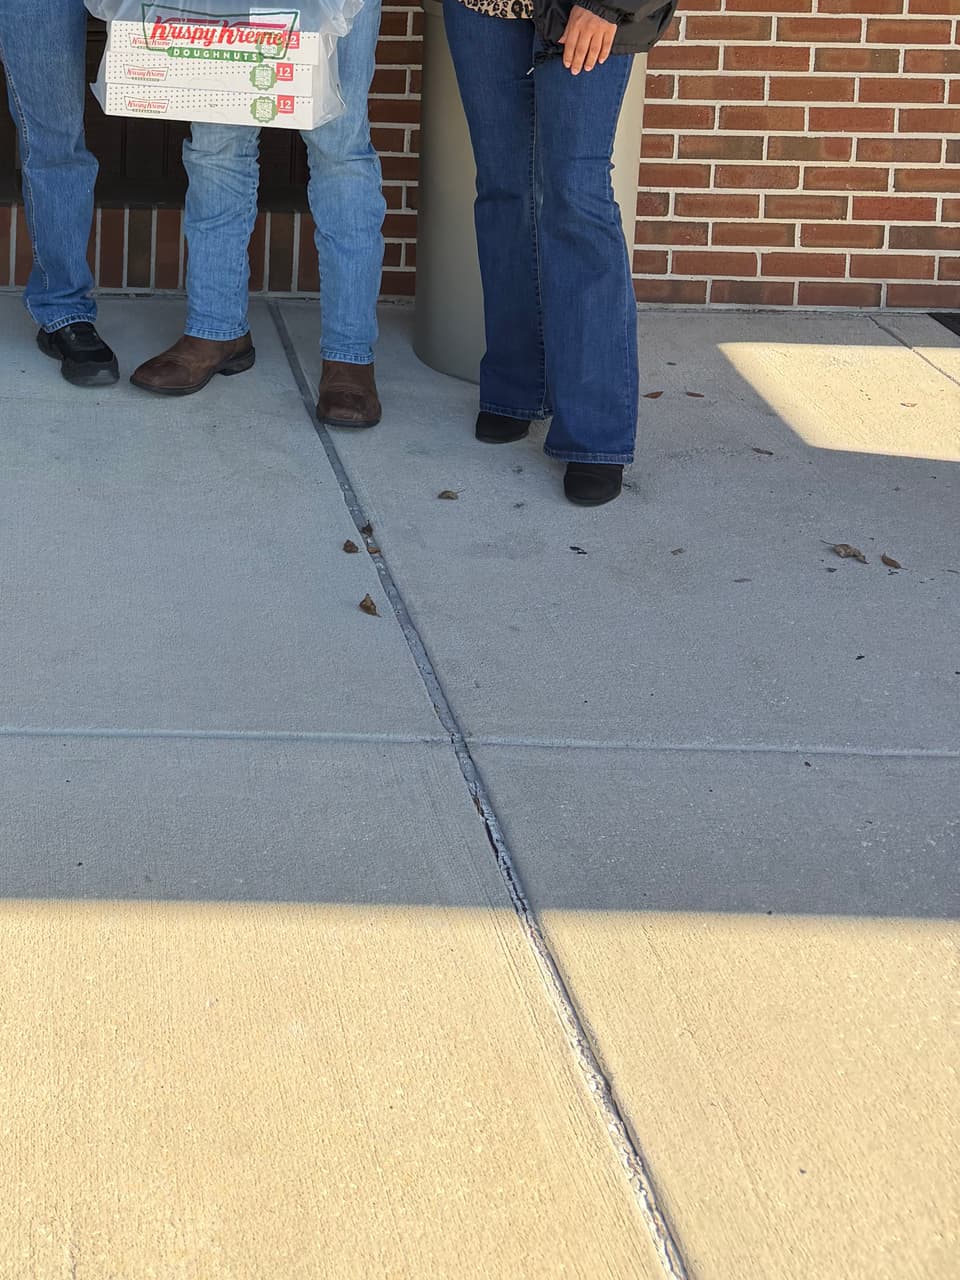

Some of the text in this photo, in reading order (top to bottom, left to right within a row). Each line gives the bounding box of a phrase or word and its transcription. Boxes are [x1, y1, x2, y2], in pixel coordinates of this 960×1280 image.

[150, 16, 286, 47] Krispy Kreme
[173, 48, 258, 62] DOUGHNUTS
[278, 67, 291, 77] 12
[279, 100, 292, 110] 12
